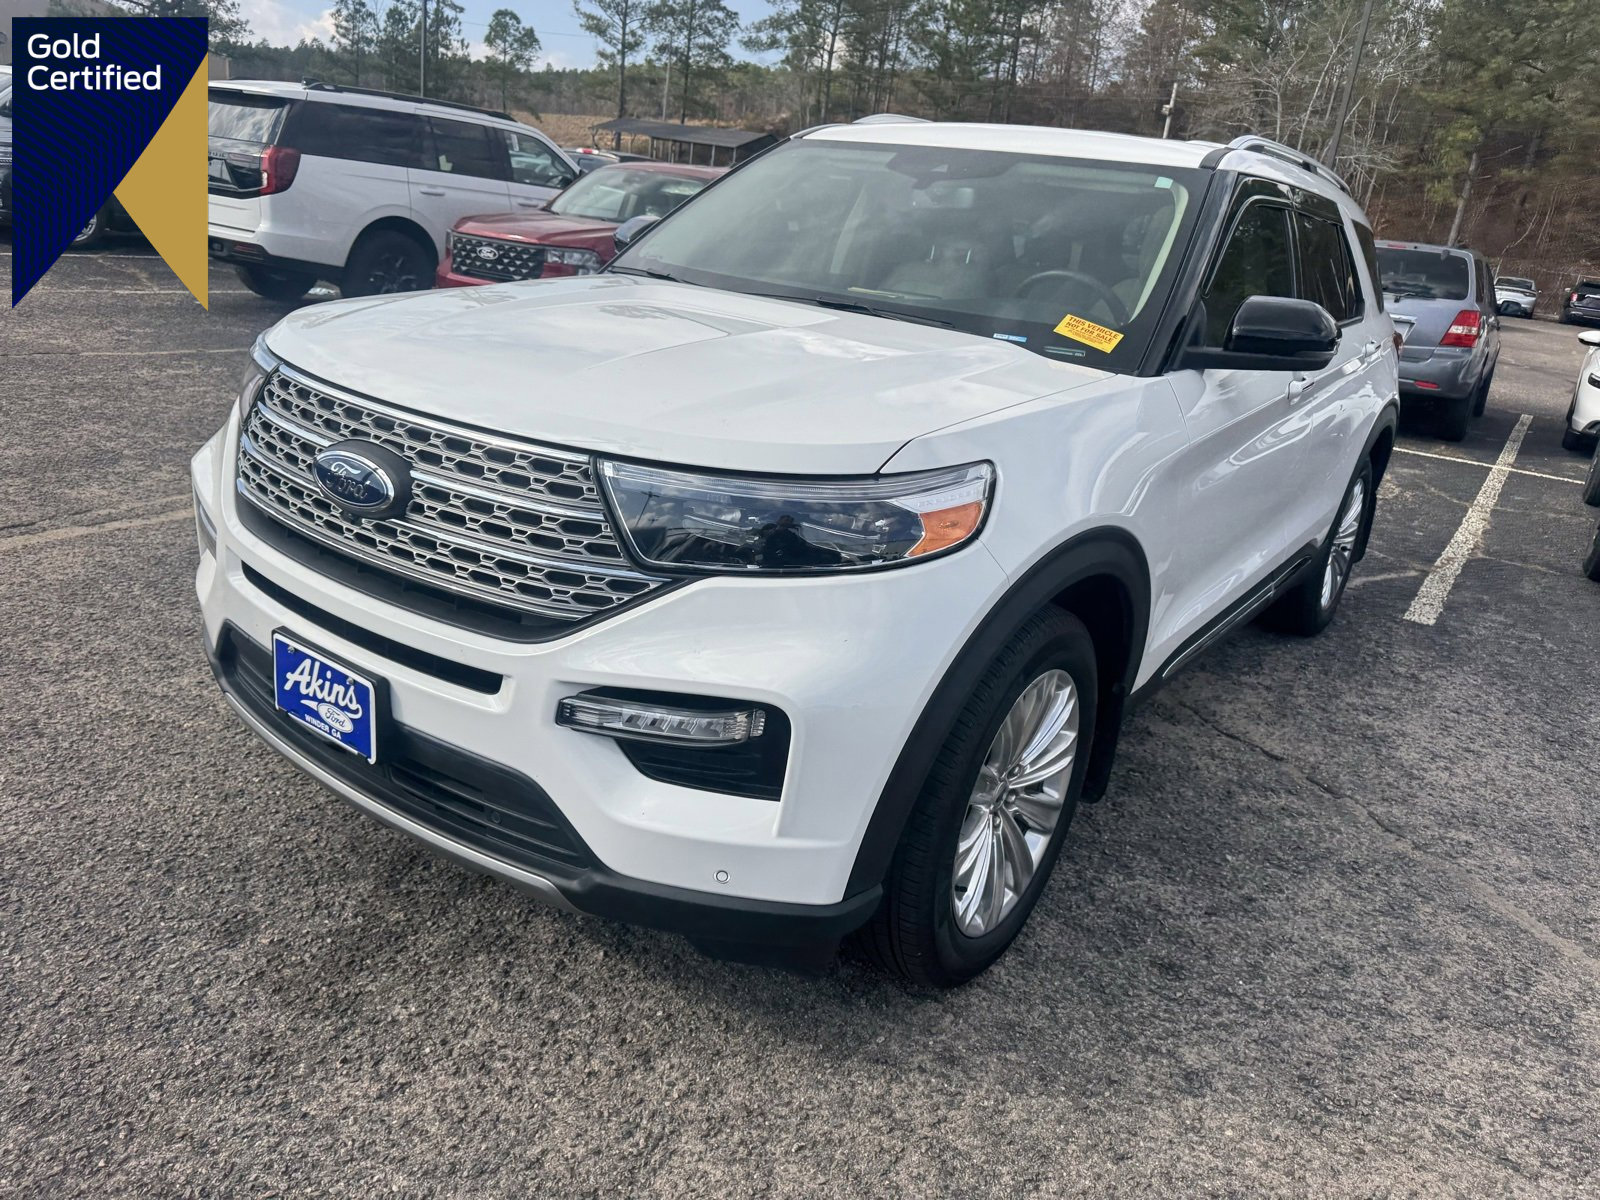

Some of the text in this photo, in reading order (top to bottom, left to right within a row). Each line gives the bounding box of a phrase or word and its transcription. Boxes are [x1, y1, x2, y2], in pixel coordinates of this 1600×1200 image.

[1066, 321, 1114, 342] NOT FOR SALE
[1069, 317, 1086, 326] THIS
[1087, 323, 1120, 340] VEHICLE
[326, 461, 372, 499] Ford
[284, 658, 362, 714] Akins
[305, 713, 342, 740] WINDER GA
[325, 707, 346, 728] Ford
